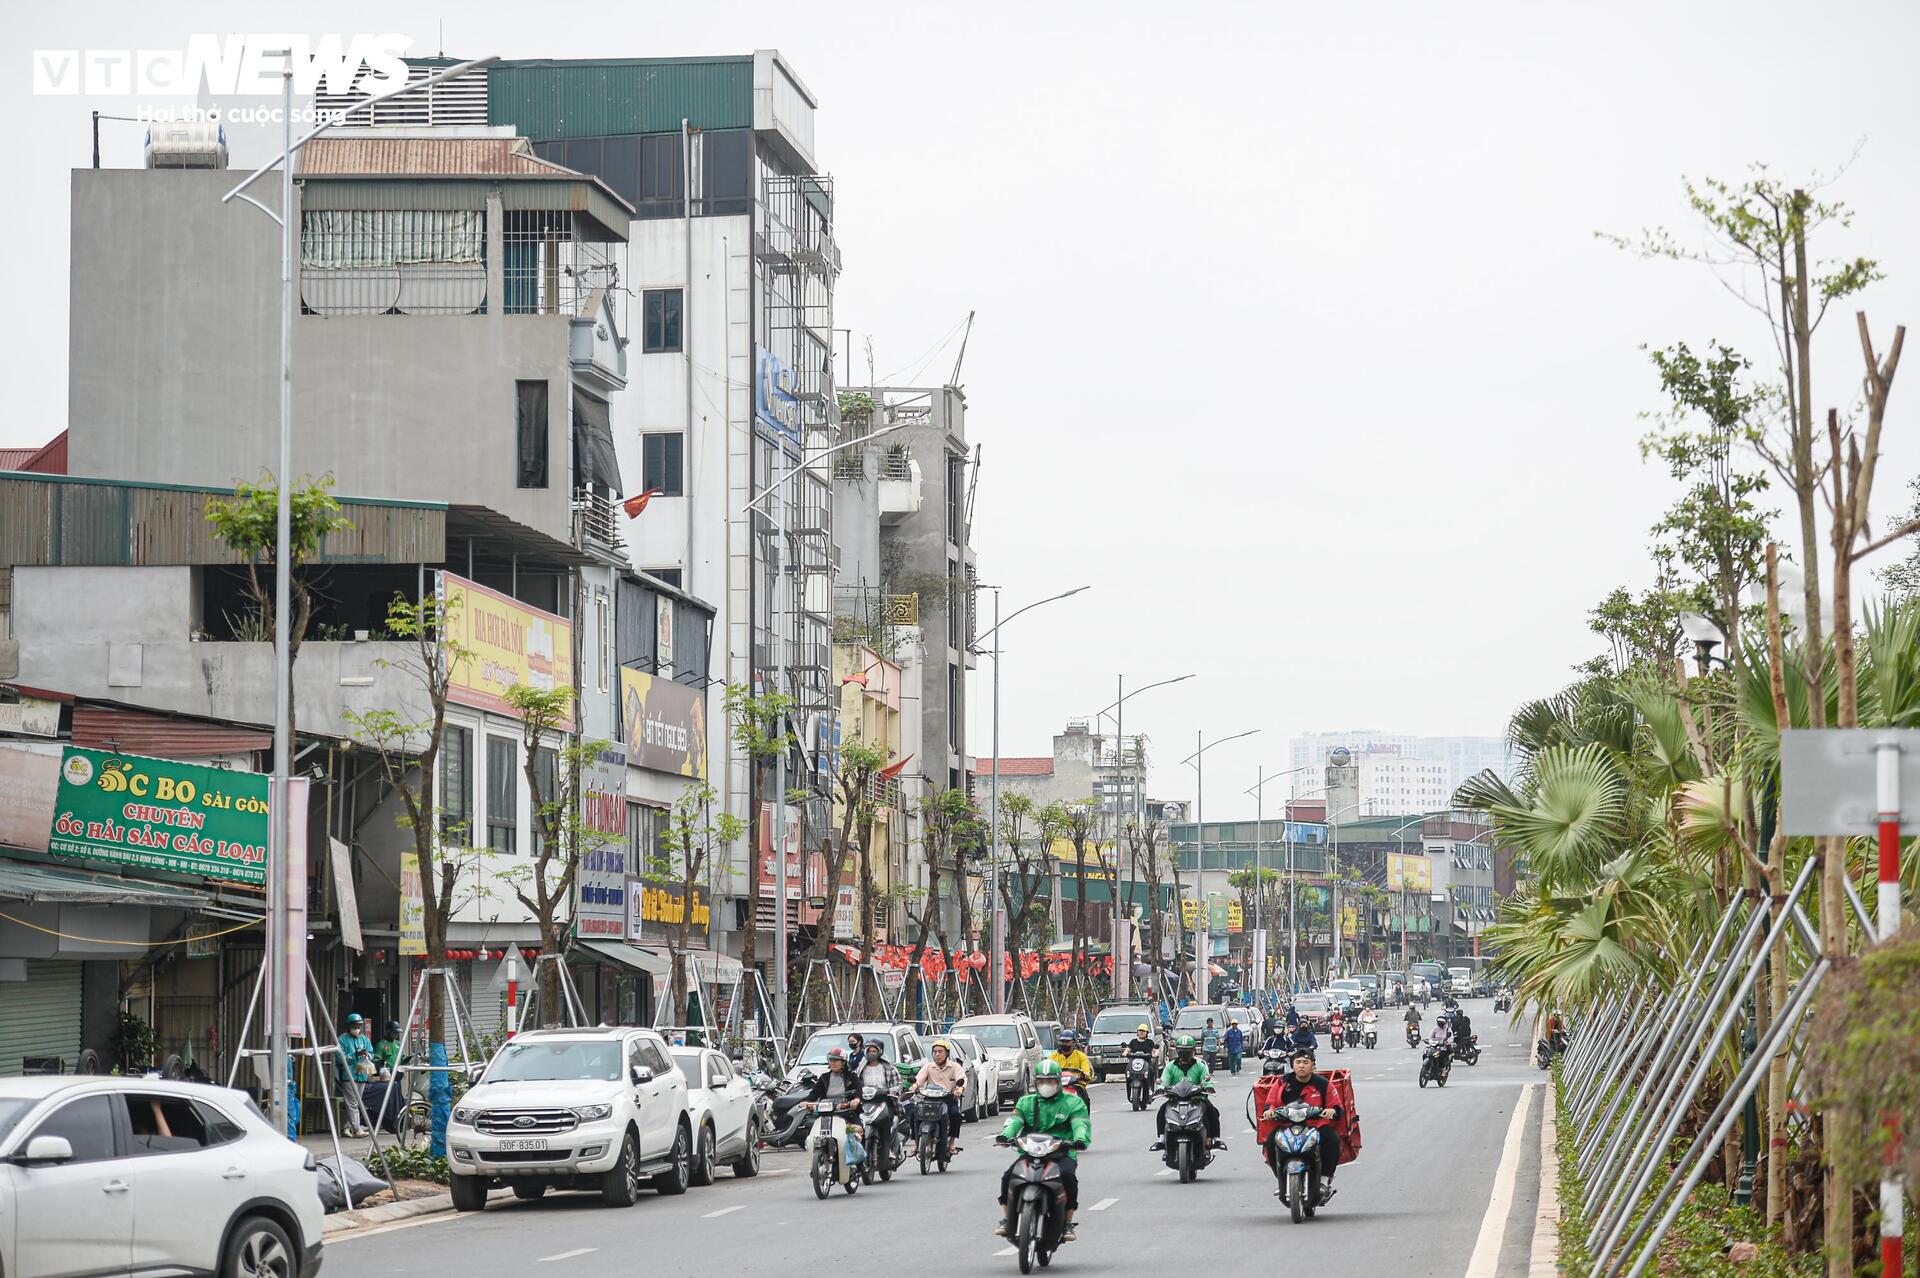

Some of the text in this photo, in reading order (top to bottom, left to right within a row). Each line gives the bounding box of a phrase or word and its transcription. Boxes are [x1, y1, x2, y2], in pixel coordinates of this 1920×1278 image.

[155, 776, 196, 803] BO
[202, 791, 231, 809] SÀI
[235, 796, 269, 815] GÒN
[123, 803, 205, 829] CHUYÊN
[56, 812, 266, 865] ỐC HẢI SẢN CÁC LOẠI
